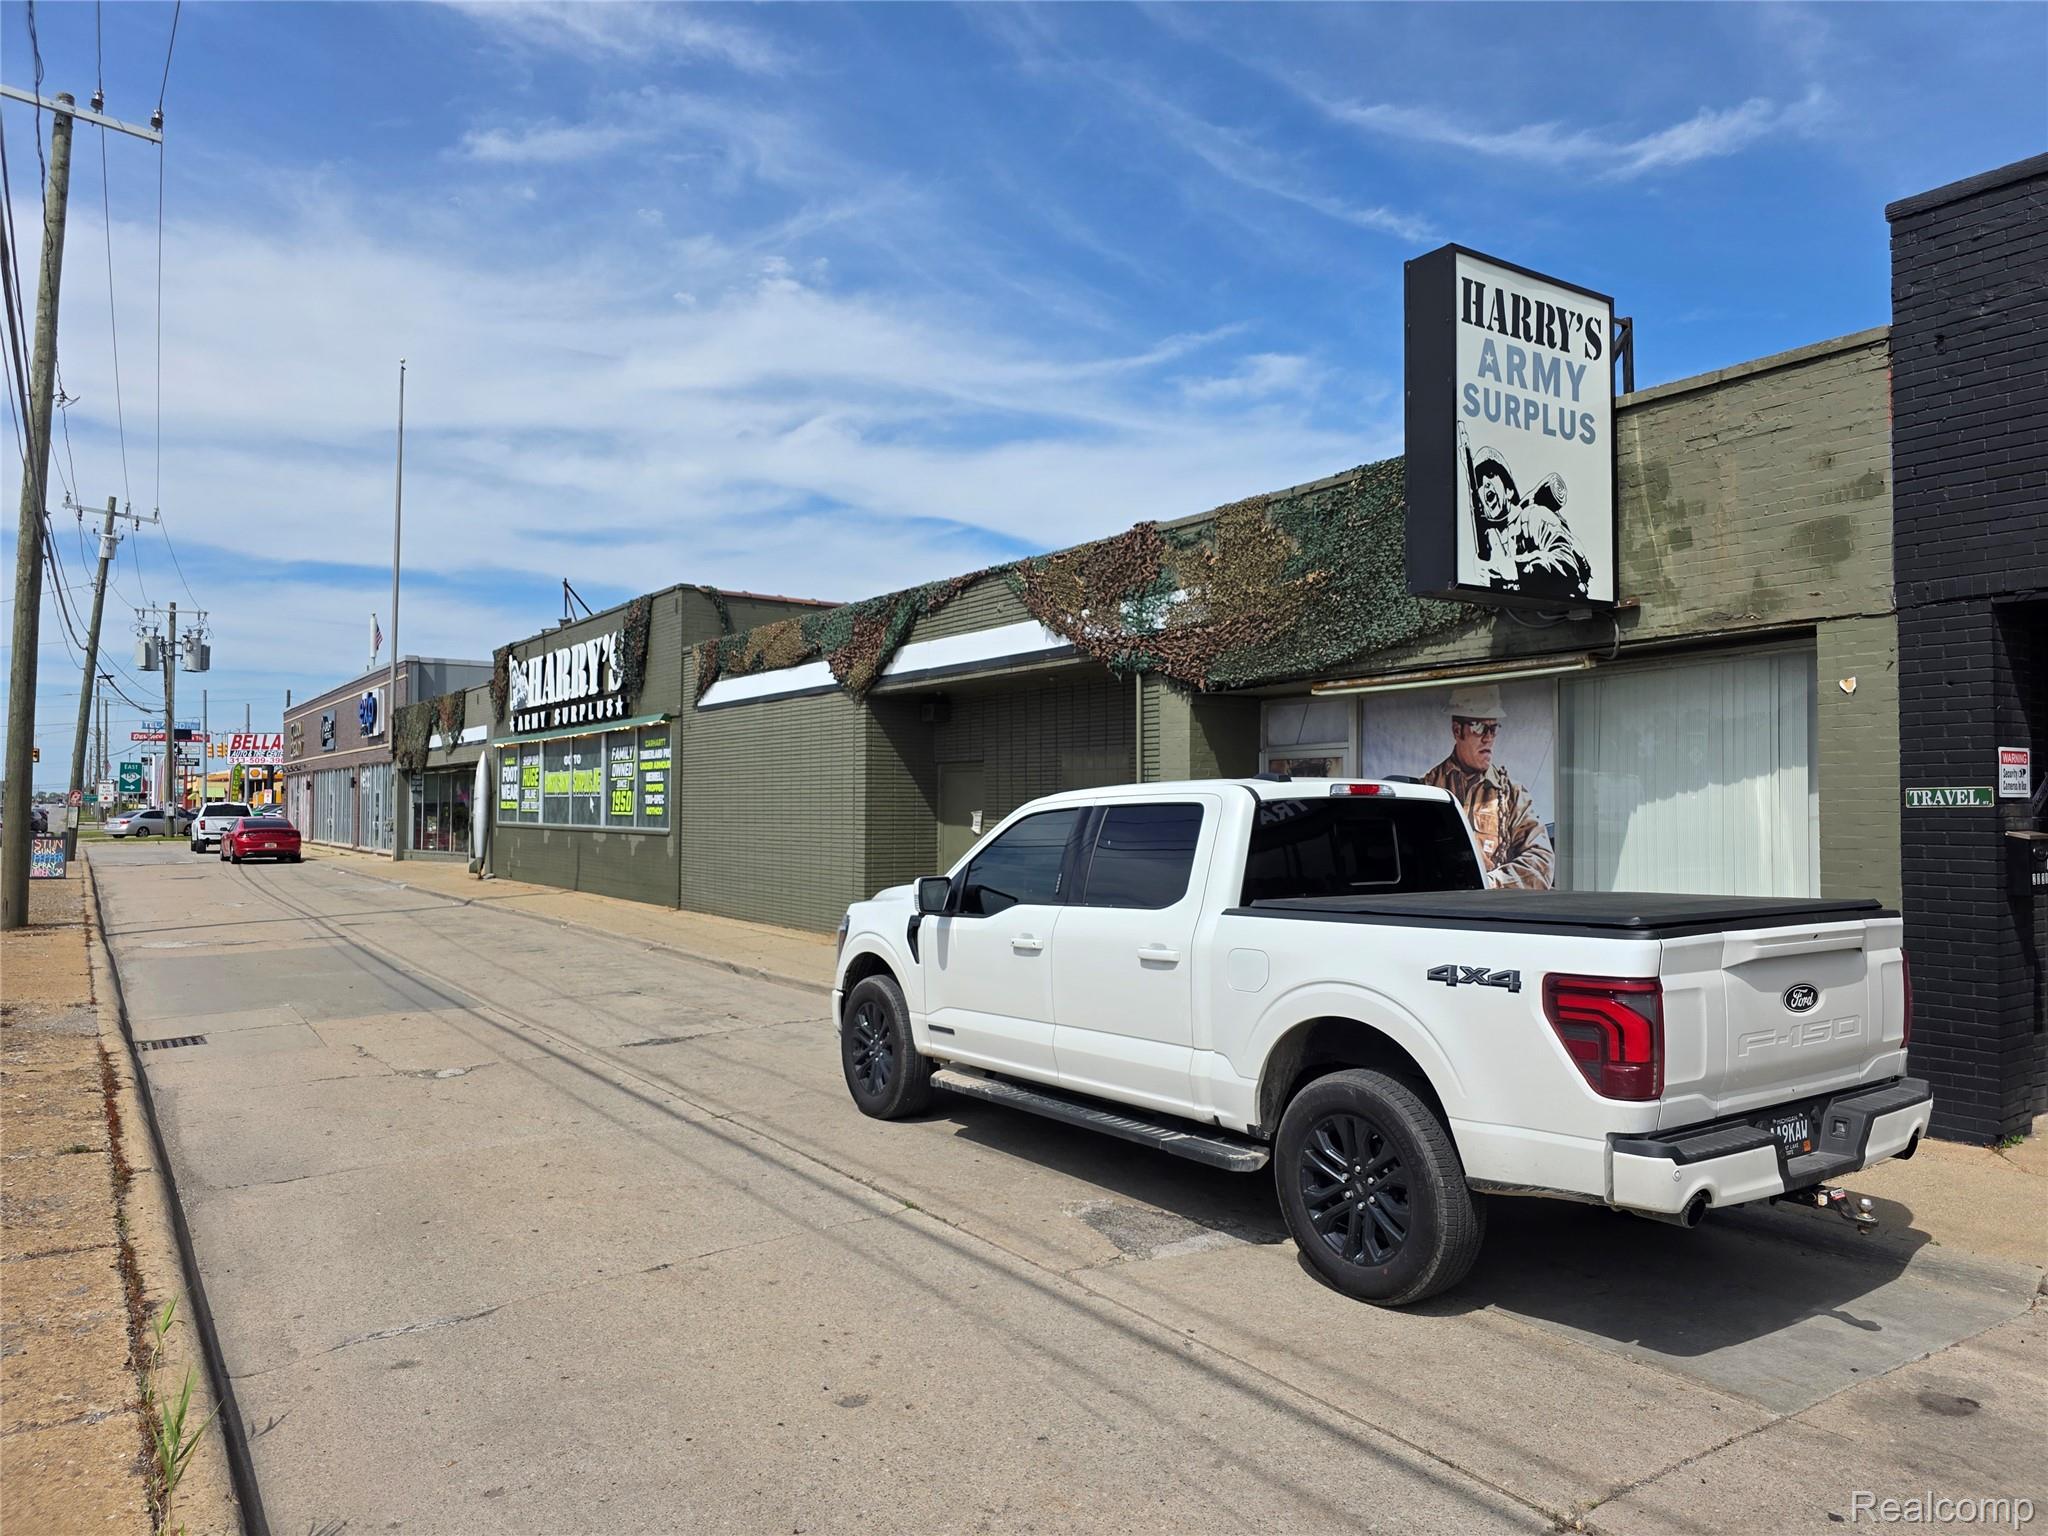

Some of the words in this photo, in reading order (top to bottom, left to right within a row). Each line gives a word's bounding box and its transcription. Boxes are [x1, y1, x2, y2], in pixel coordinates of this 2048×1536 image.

[1461, 277, 1602, 361] HARRY'S
[1477, 338, 1587, 402] ARMY
[1463, 382, 1597, 445] SURPLUS
[517, 711, 546, 731] ARMY
[554, 698, 614, 726] SURPLUS
[231, 734, 284, 750] BELLA
[573, 754, 581, 765] TO
[611, 745, 634, 761] FAMILY
[2002, 752, 2027, 764] WARNING
[502, 766, 518, 783] FOOT
[522, 767, 539, 787] HUGE
[611, 762, 634, 777] OWNED
[2003, 768, 2018, 781] Security
[612, 790, 632, 812] 1950
[1909, 789, 1980, 806] TRAVEL
[33, 847, 57, 856] GUNS
[34, 839, 63, 849] STUN
[32, 862, 57, 870] SPRAY
[1788, 988, 1815, 1009] Ford
[1738, 1014, 1862, 1057] F-150
